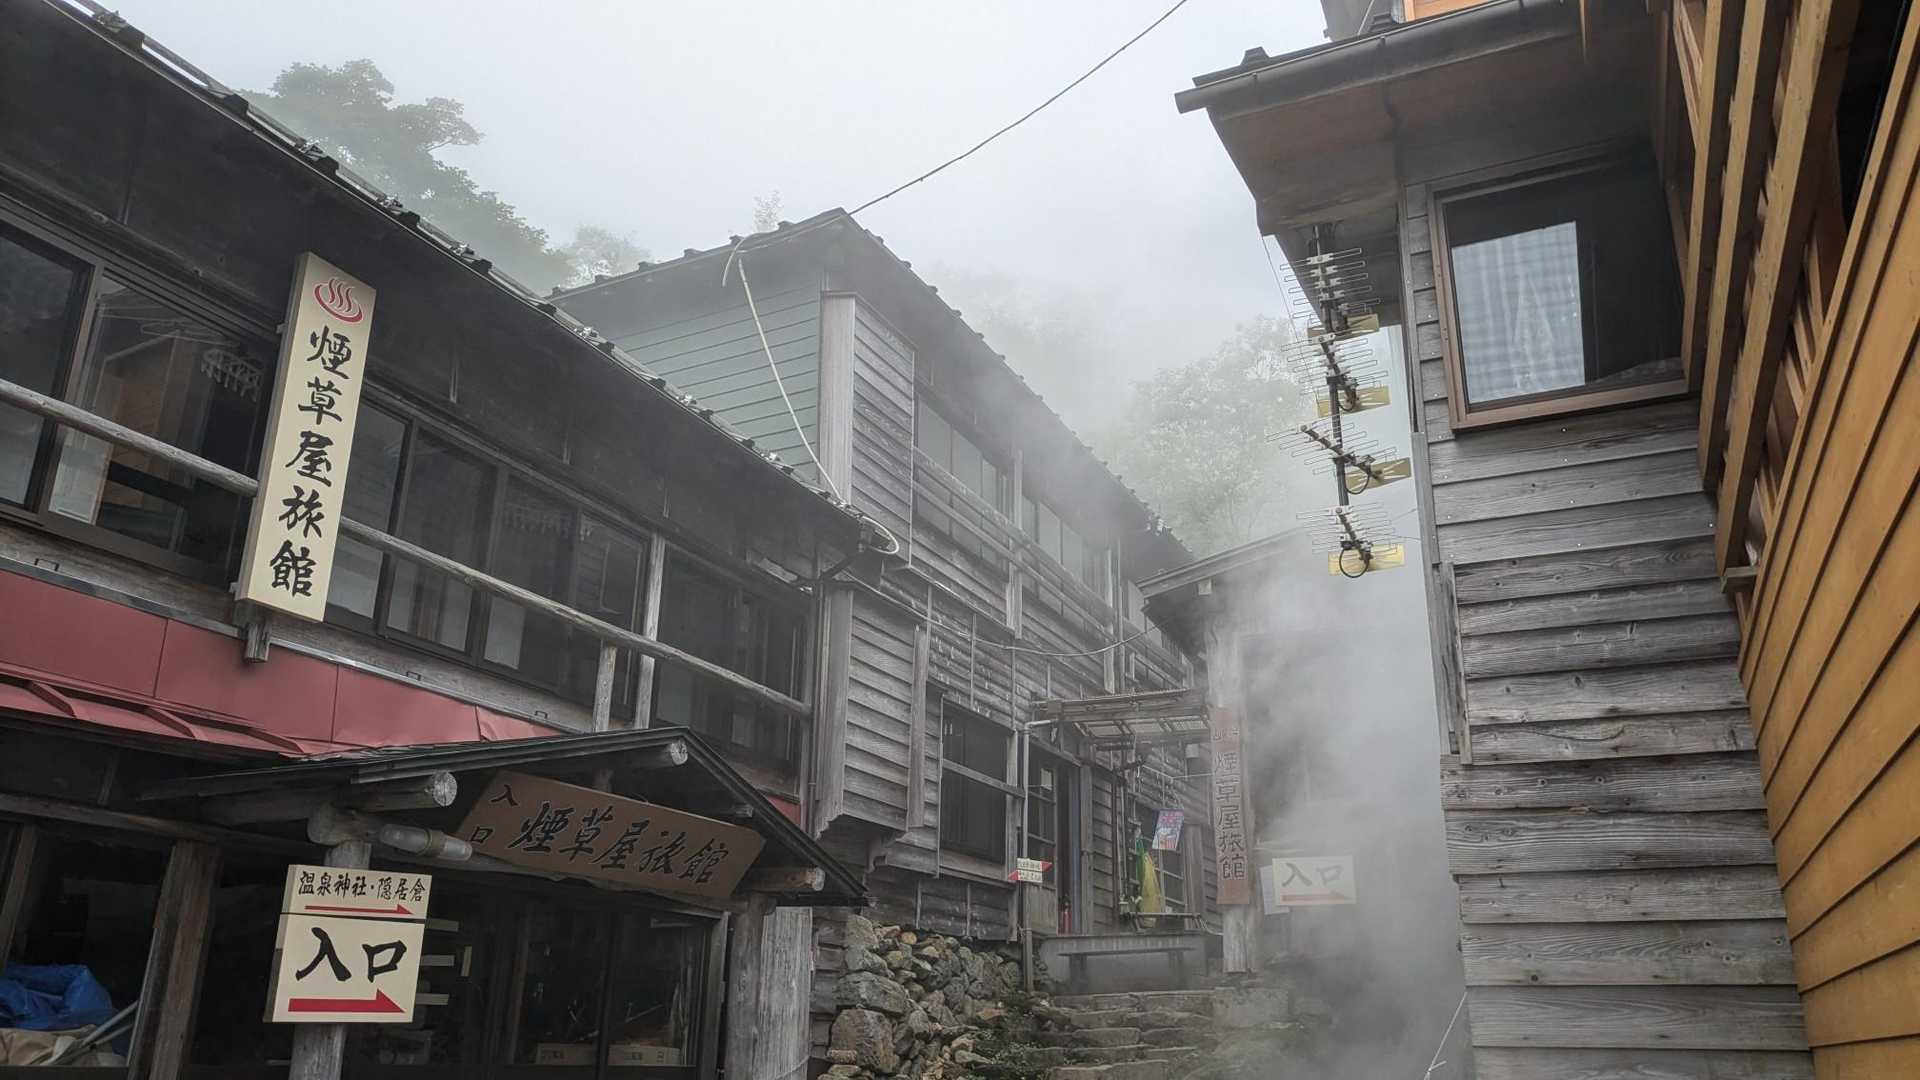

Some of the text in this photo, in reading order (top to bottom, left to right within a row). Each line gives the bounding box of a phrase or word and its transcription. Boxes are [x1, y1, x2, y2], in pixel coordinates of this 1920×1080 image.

[270, 325, 352, 597] 煙草屋旅館
[508, 800, 729, 884] 煙草屋旅館
[1215, 752, 1245, 880] 煙草屋旅館
[1282, 863, 1343, 887] 入口
[295, 927, 407, 983] 入口
